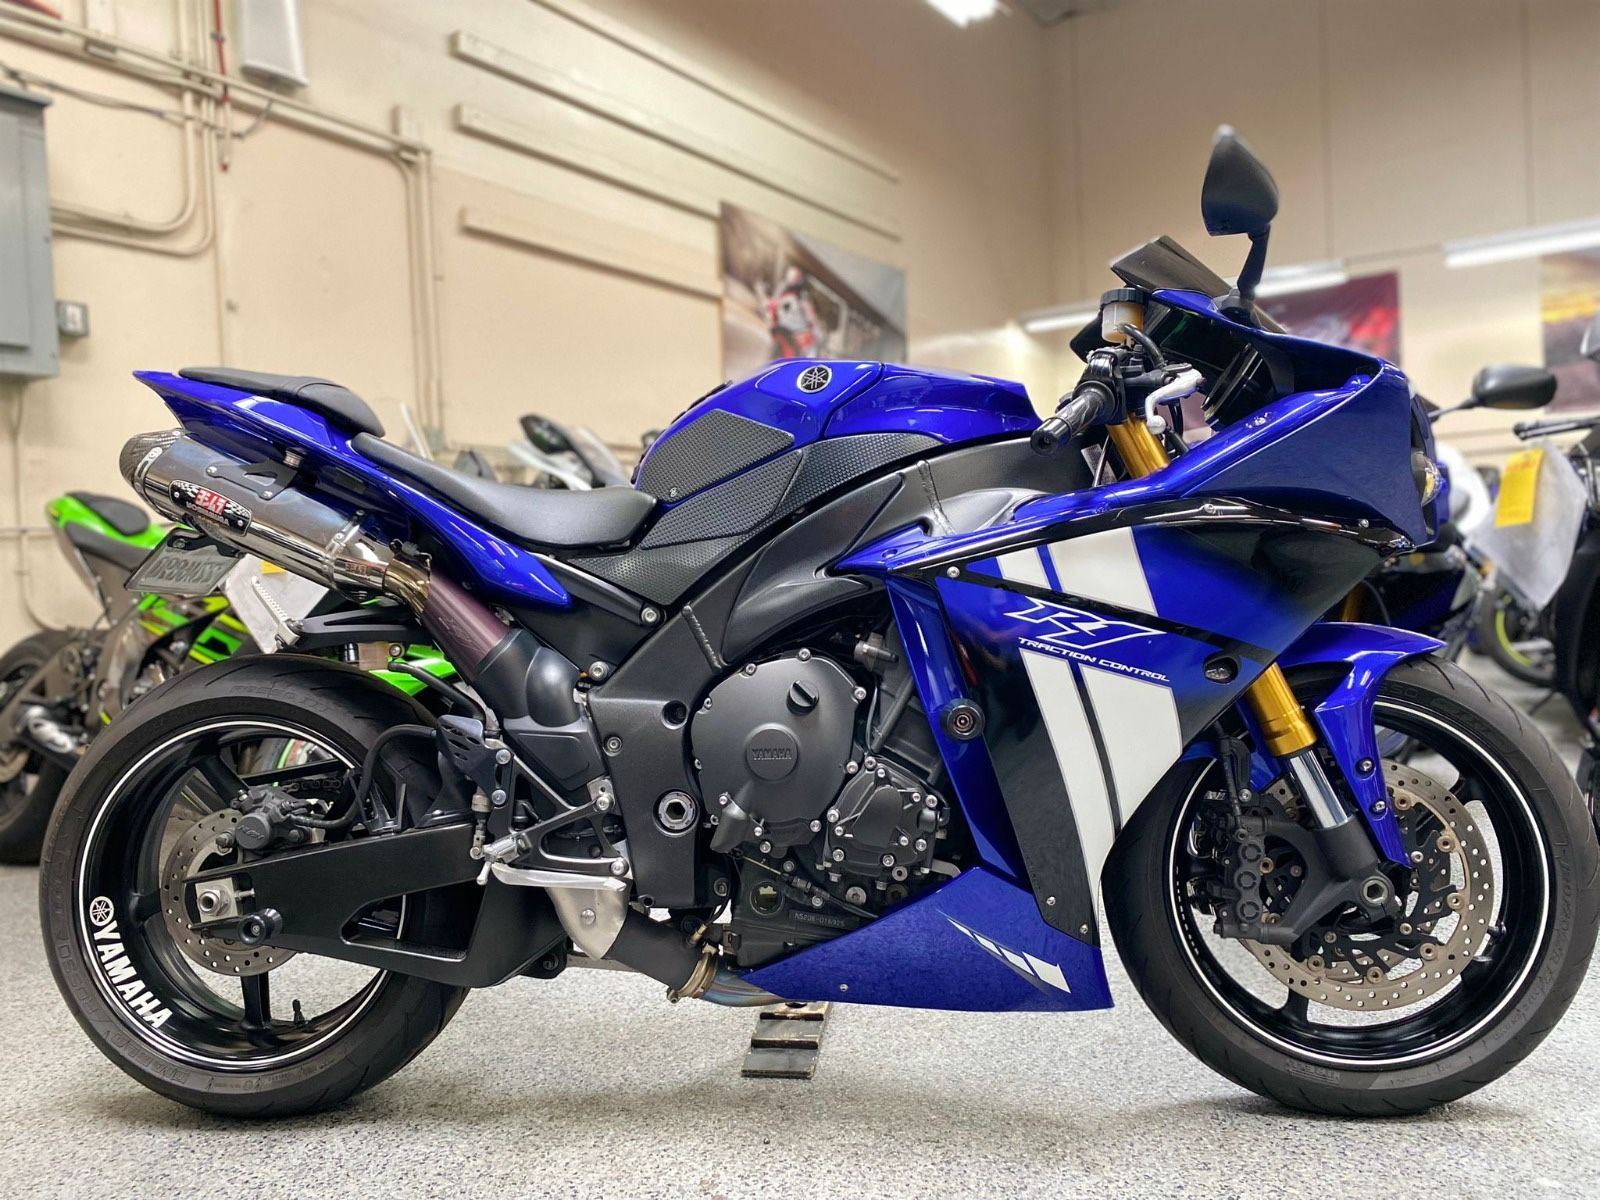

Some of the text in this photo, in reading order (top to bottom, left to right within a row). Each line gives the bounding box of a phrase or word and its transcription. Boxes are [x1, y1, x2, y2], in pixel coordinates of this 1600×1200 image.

[1018, 637, 1170, 682] TRACTION CONTROL
[752, 748, 792, 760] YAMAHA
[93, 920, 173, 1028] YAMAHA
